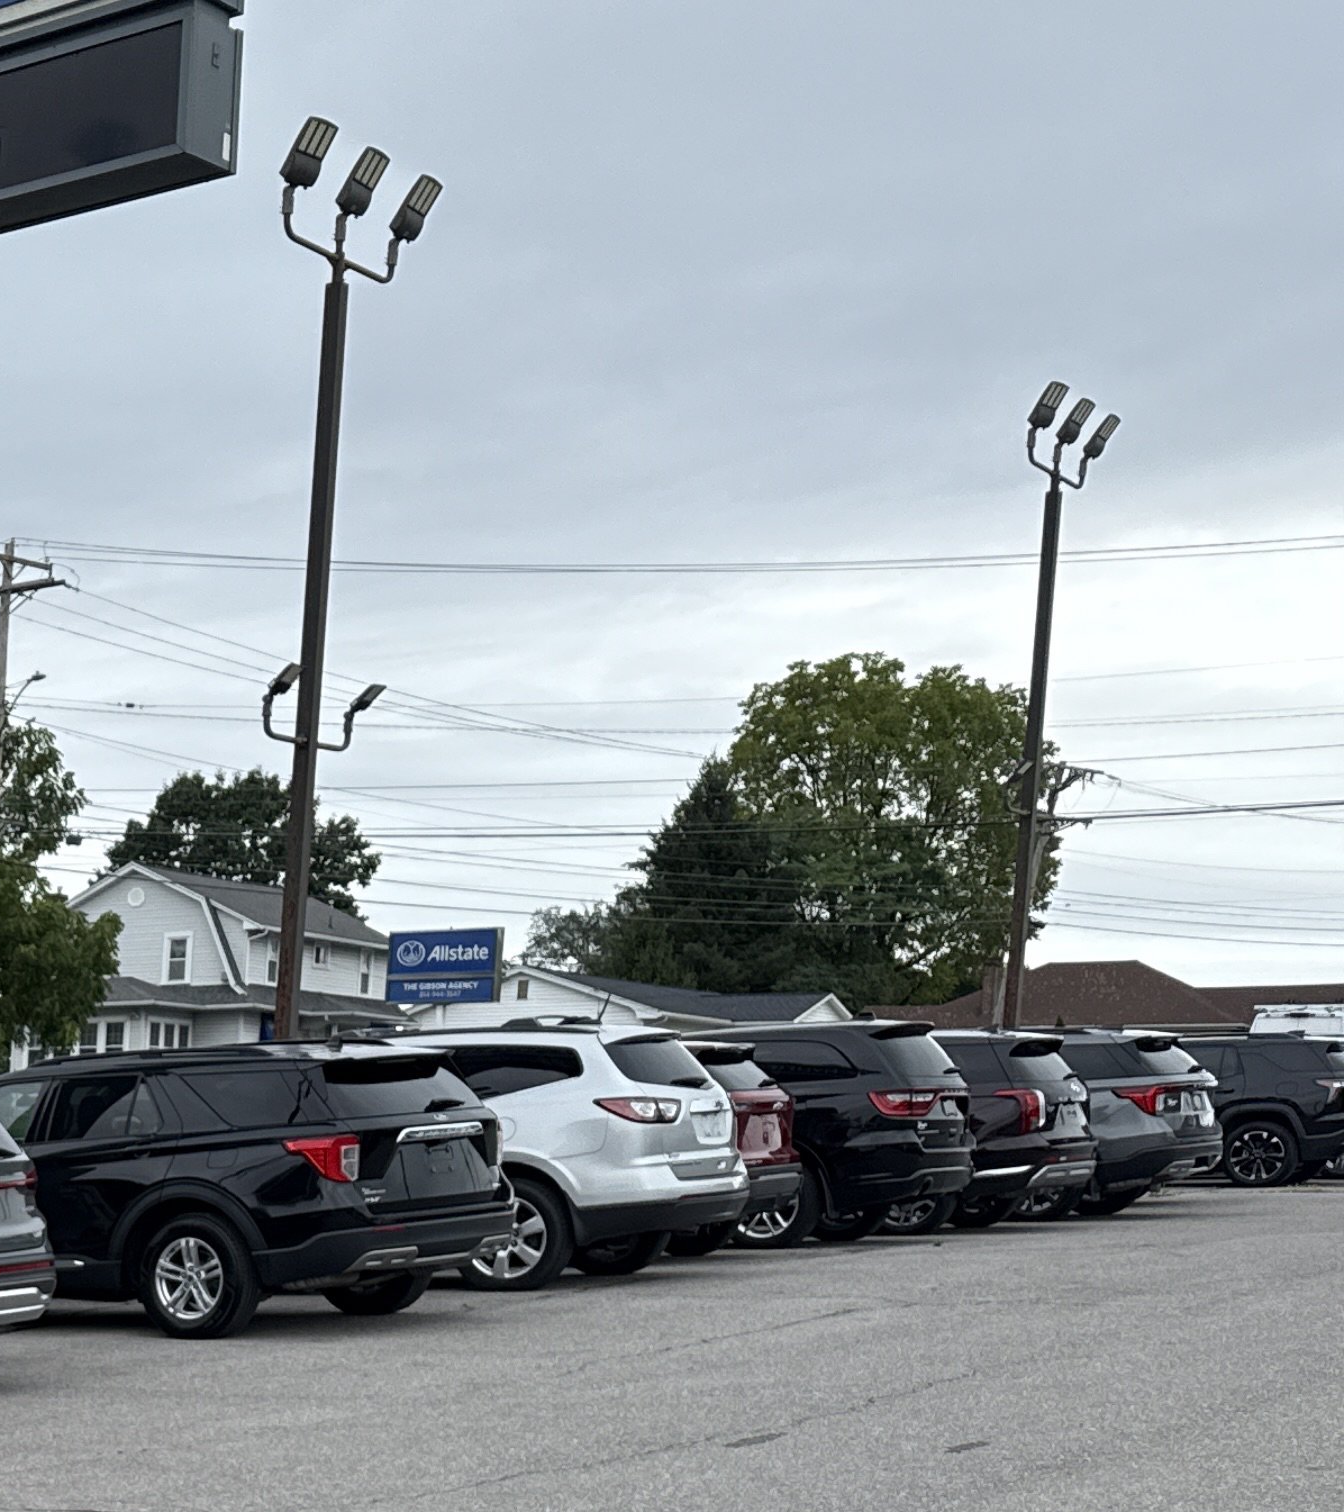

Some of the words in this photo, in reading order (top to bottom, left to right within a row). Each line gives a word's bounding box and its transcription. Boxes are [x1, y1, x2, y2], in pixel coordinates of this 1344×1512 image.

[427, 944, 489, 962] Allstate
[403, 982, 418, 991] THE
[448, 981, 479, 989] AGENCY
